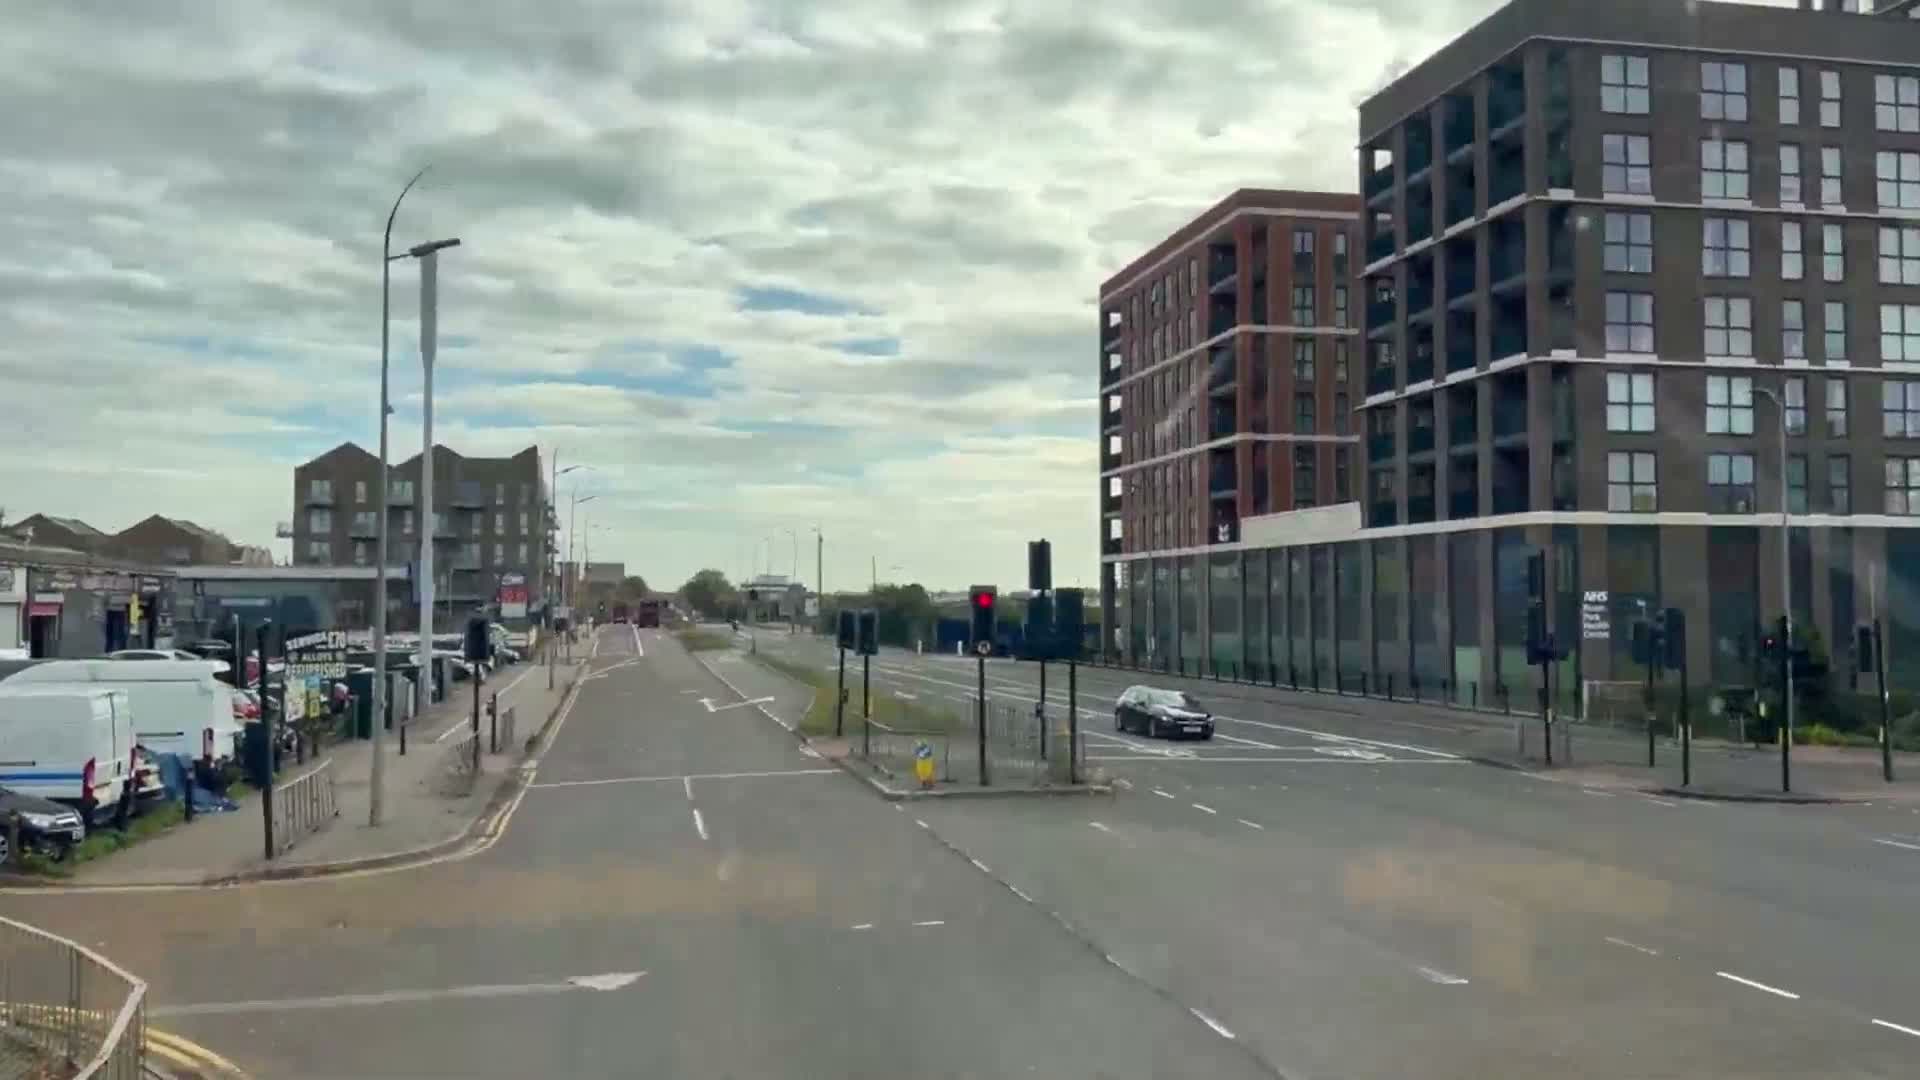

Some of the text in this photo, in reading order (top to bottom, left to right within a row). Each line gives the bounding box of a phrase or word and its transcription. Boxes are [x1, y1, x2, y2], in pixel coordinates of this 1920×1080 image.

[1583, 591, 1609, 602] NHS
[327, 631, 346, 649] £70
[1583, 631, 1610, 639] Centre
